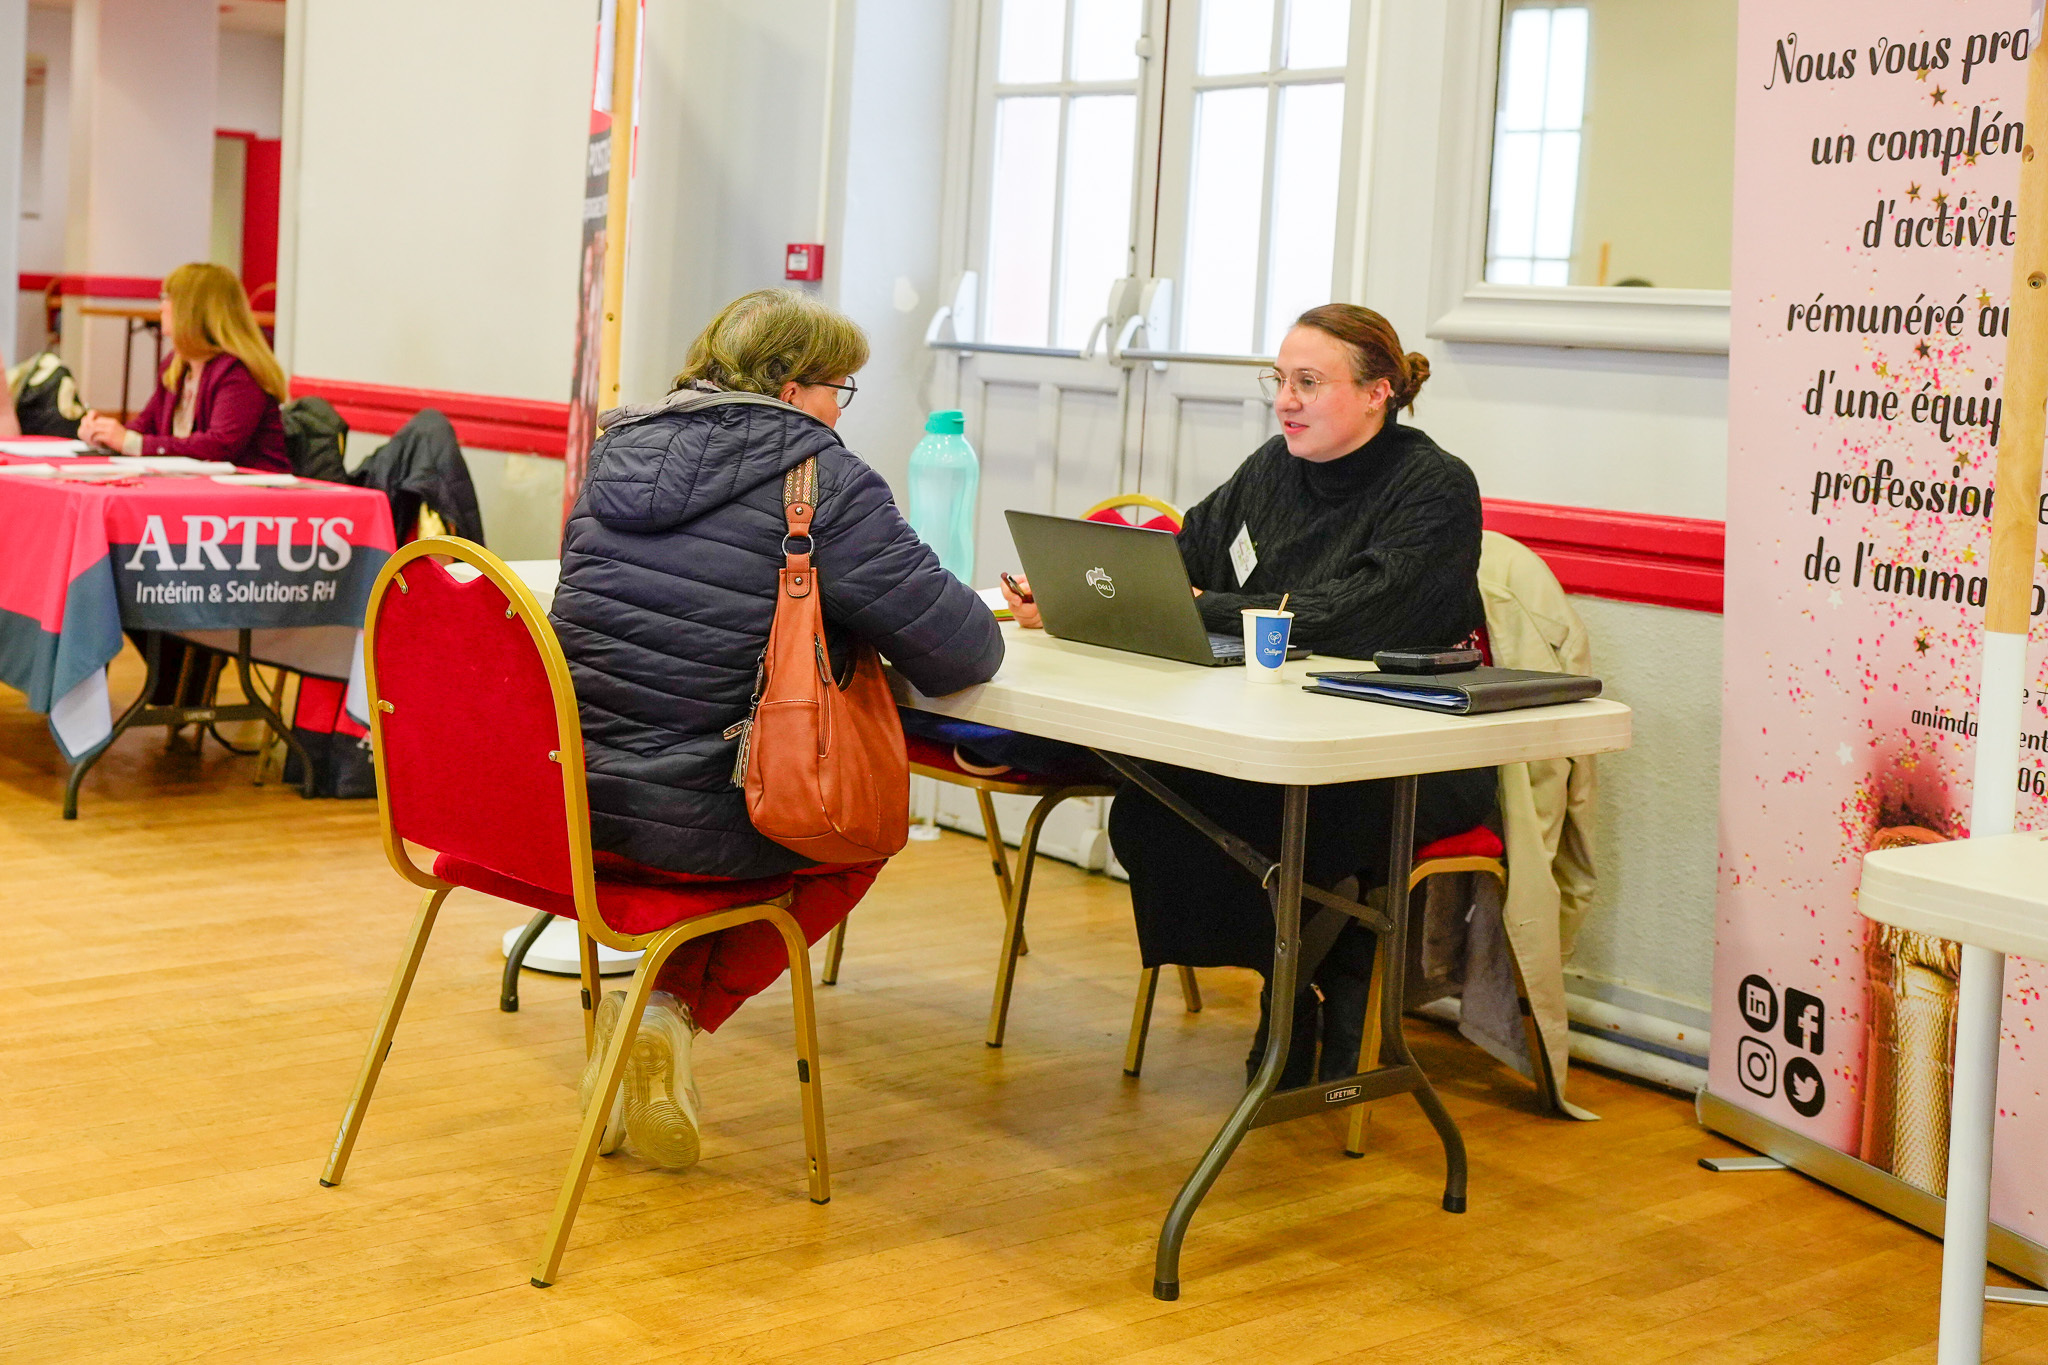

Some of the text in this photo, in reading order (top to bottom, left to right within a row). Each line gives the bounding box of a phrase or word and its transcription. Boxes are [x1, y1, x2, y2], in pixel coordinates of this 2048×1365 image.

[1764, 32, 1857, 90] Nous
[1868, 37, 1951, 76] vous
[1811, 134, 1855, 165] un
[1862, 195, 2017, 248] d'activit
[1787, 292, 1968, 337] rémunéré
[1805, 369, 1898, 421] d'une
[124, 514, 354, 572] ARTUS
[1804, 536, 1841, 584] de
[135, 579, 337, 604] Intérim & Solutions RH
